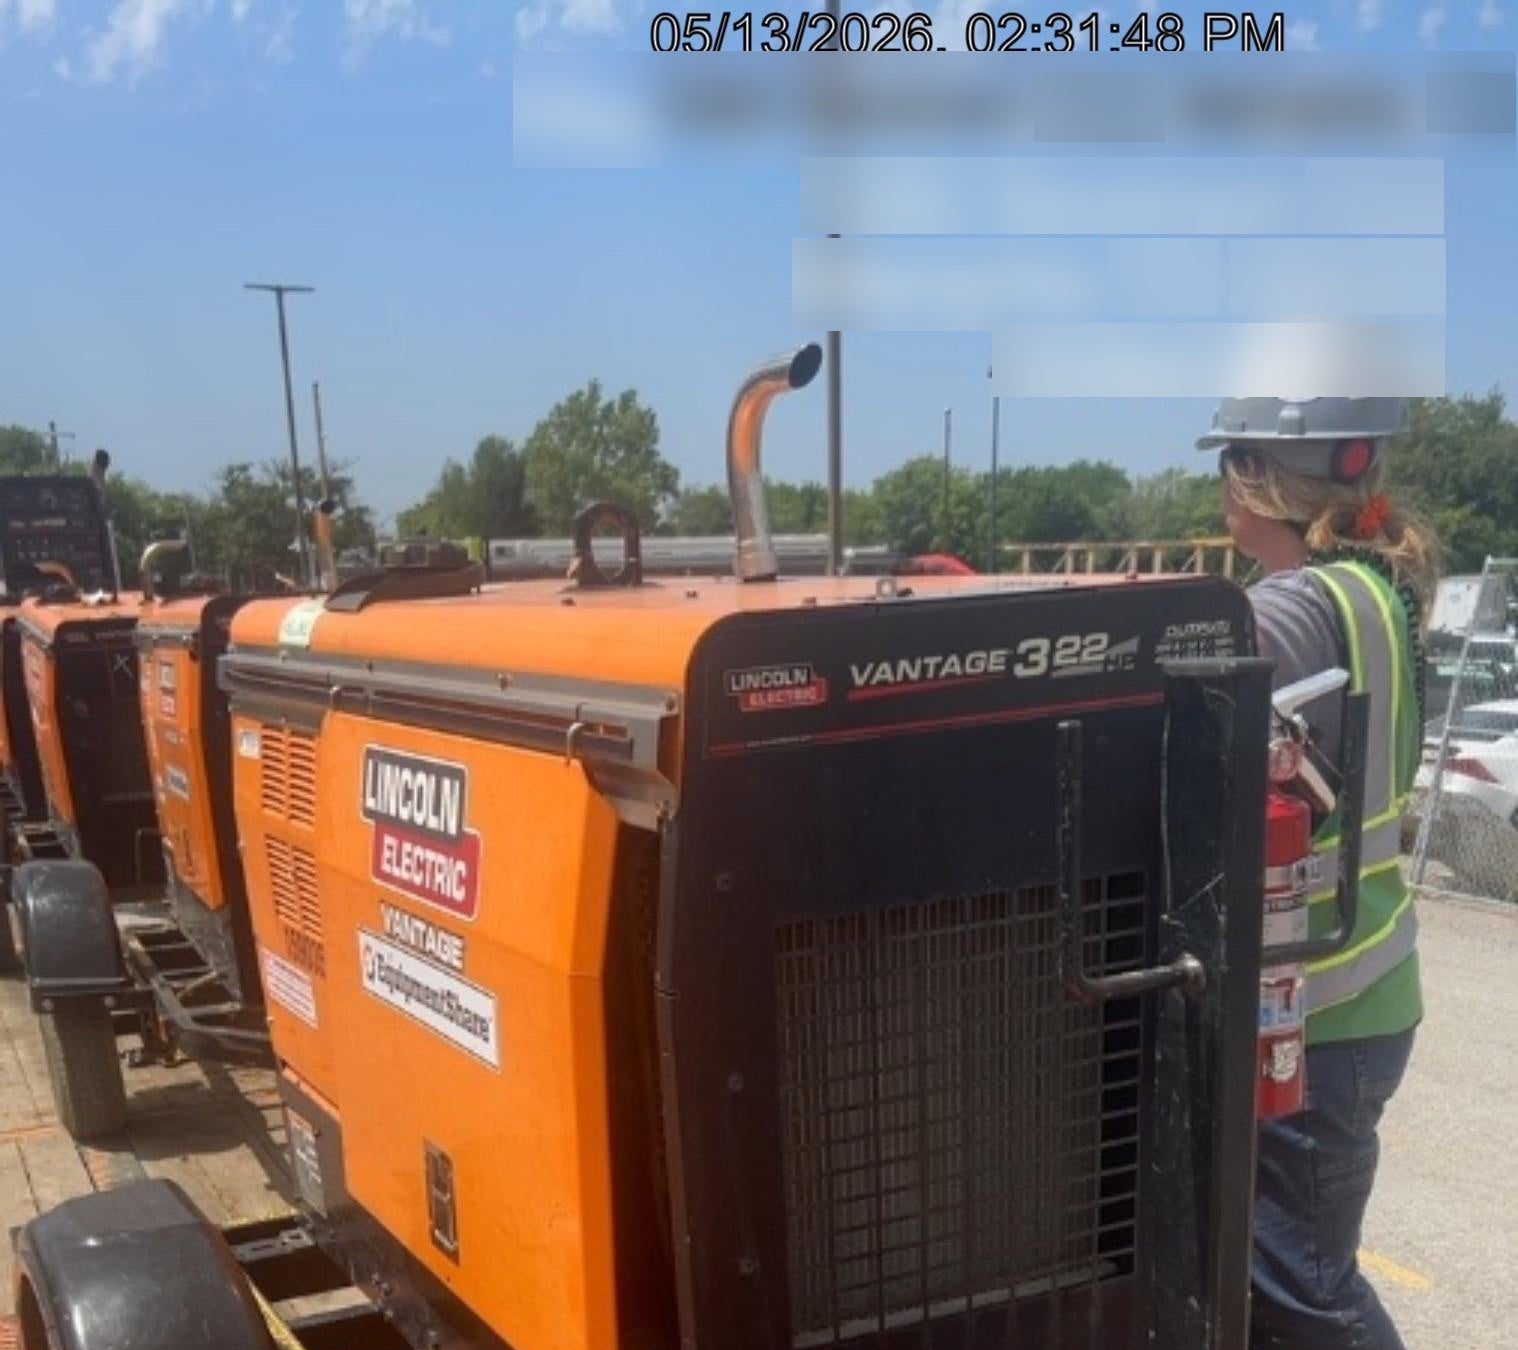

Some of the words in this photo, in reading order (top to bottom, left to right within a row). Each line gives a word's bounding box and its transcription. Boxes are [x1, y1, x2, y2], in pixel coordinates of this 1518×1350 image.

[730, 667, 809, 692] LINCOLN
[850, 651, 1008, 687] VANTAGE
[1013, 632, 1109, 679] 322
[749, 685, 818, 707] ELECTRIC
[364, 758, 461, 837] LINCOLN
[380, 832, 467, 902] ELECTRIC
[379, 899, 465, 975] VANTAGE
[376, 950, 491, 1045] EquipmentShare
